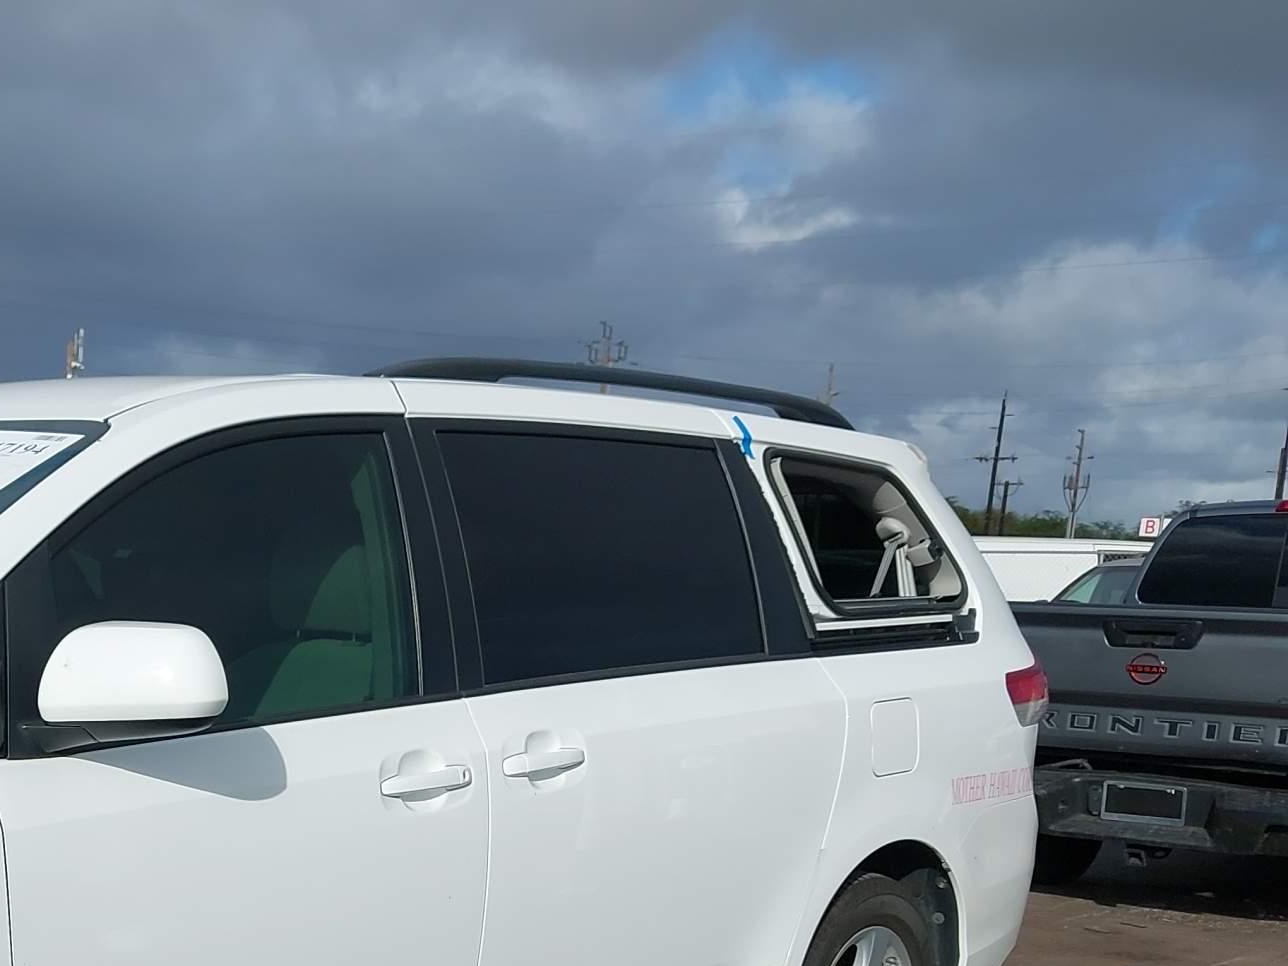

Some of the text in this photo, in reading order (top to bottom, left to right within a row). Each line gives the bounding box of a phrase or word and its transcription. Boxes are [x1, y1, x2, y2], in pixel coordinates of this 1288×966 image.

[1144, 519, 1156, 534] B
[1127, 664, 1167, 674] NISSAN
[951, 773, 986, 806] MOTHER
